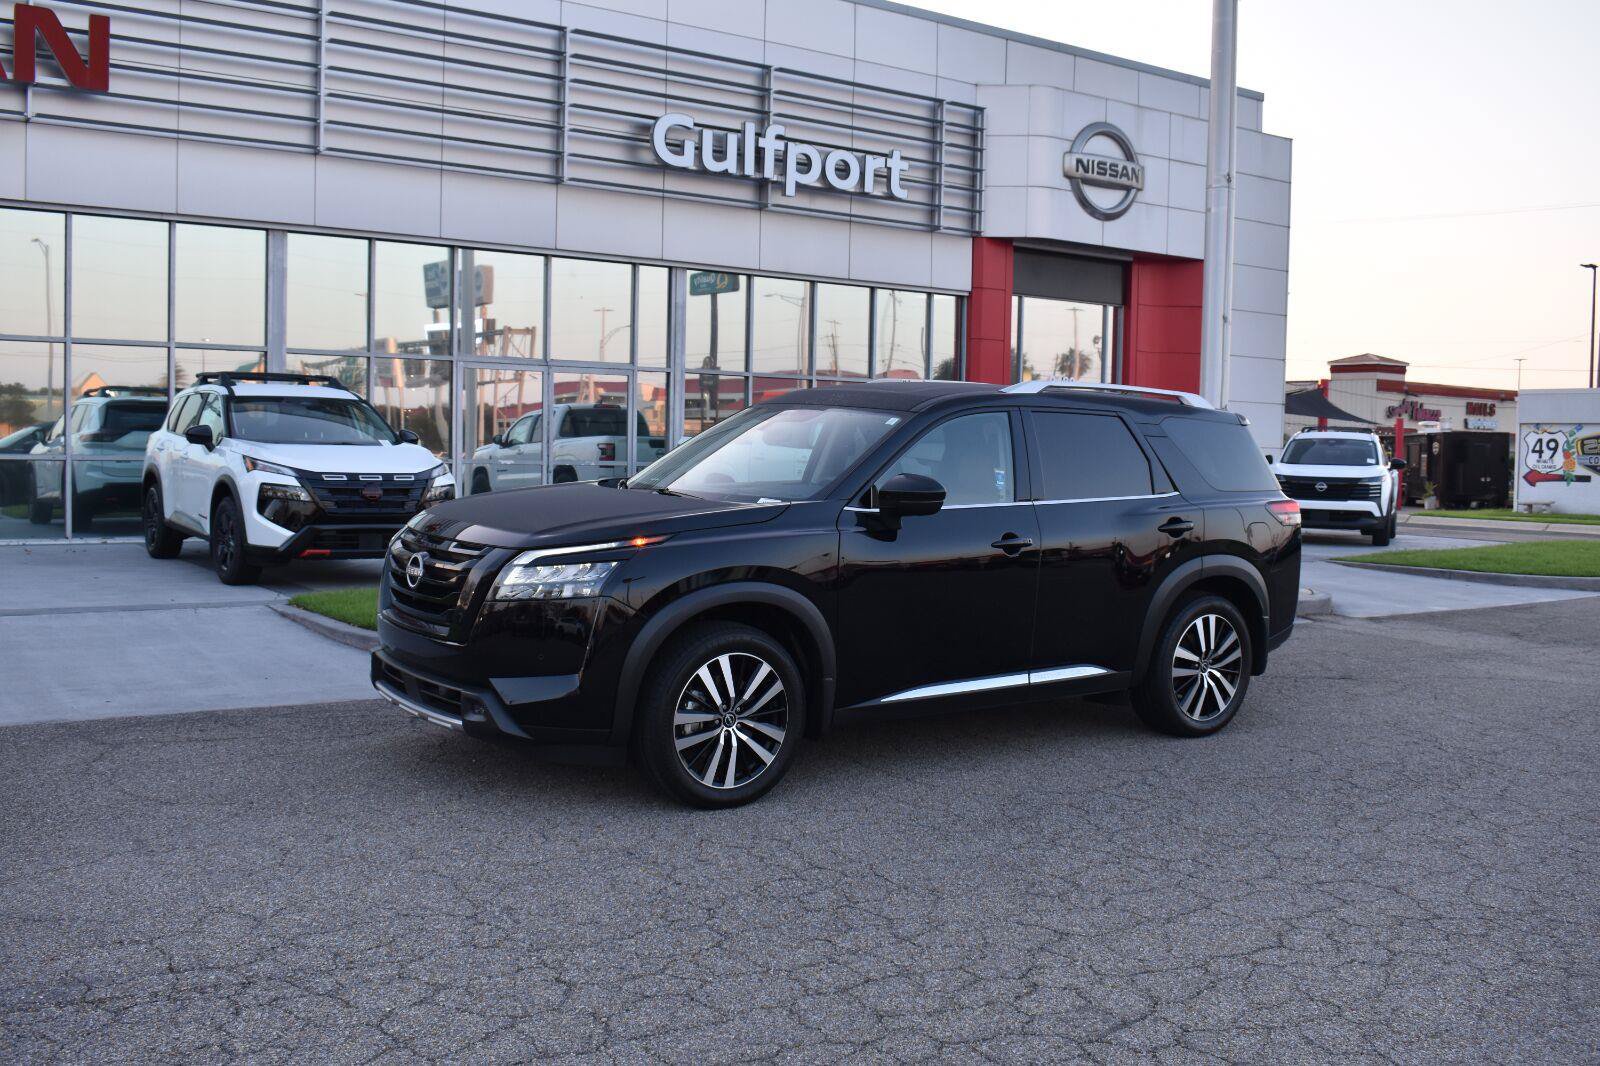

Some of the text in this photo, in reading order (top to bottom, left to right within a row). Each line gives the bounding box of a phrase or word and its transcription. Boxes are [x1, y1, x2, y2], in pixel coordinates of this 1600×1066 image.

[0, 3, 110, 92] N
[652, 112, 910, 200] Gulfport
[1075, 157, 1140, 184] NISSAN
[1531, 438, 1559, 460] 49
